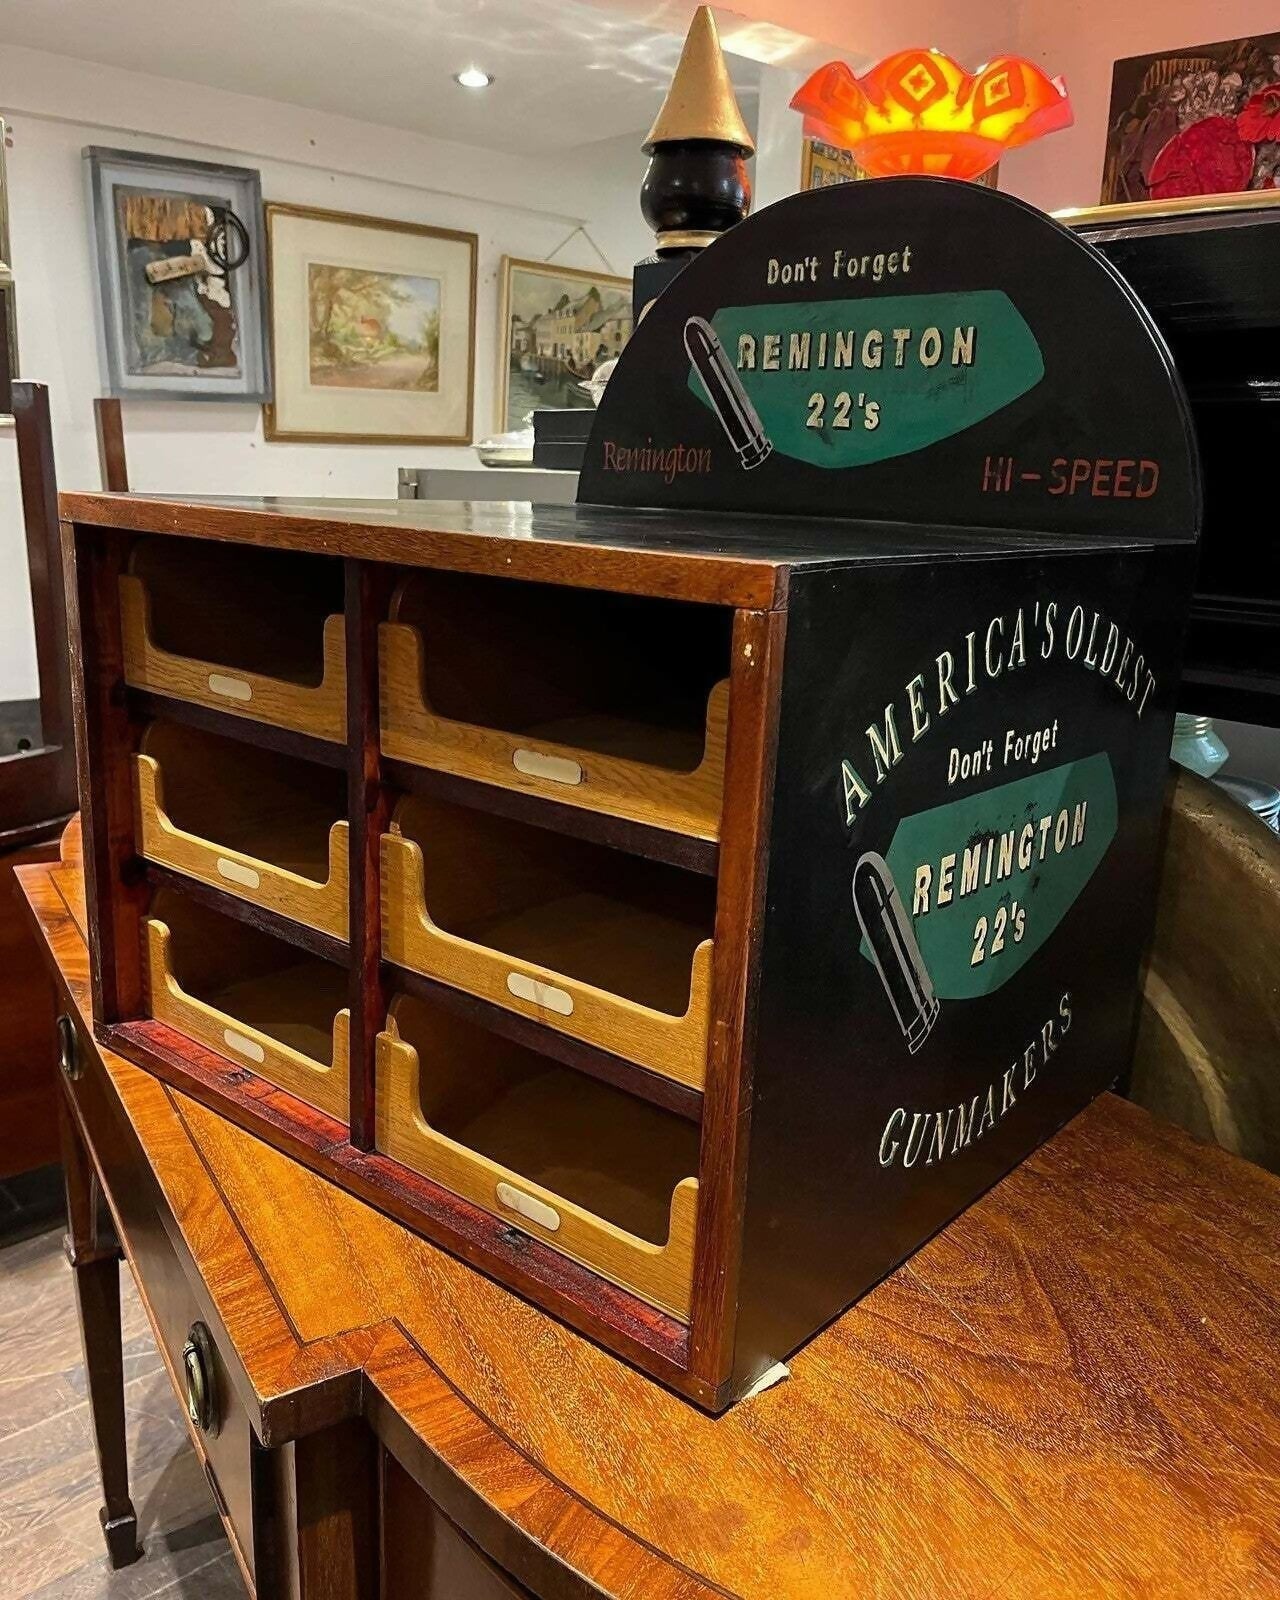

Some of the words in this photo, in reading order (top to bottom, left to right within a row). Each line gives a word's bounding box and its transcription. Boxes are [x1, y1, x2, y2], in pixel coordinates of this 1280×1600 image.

[767, 256, 819, 286] Don't
[832, 245, 912, 280] Forget
[736, 325, 976, 371] REMINGTON
[806, 393, 881, 430] 22's
[602, 437, 712, 484] Remington
[839, 601, 1058, 826] AMERICA'S
[1066, 604, 1156, 720] OLDEST
[947, 743, 993, 785] Don't
[1004, 719, 1058, 768] Forget
[912, 801, 1089, 917] REMINGTON
[970, 902, 1026, 966] 22's
[879, 992, 1073, 1169] GUNMAKERS
